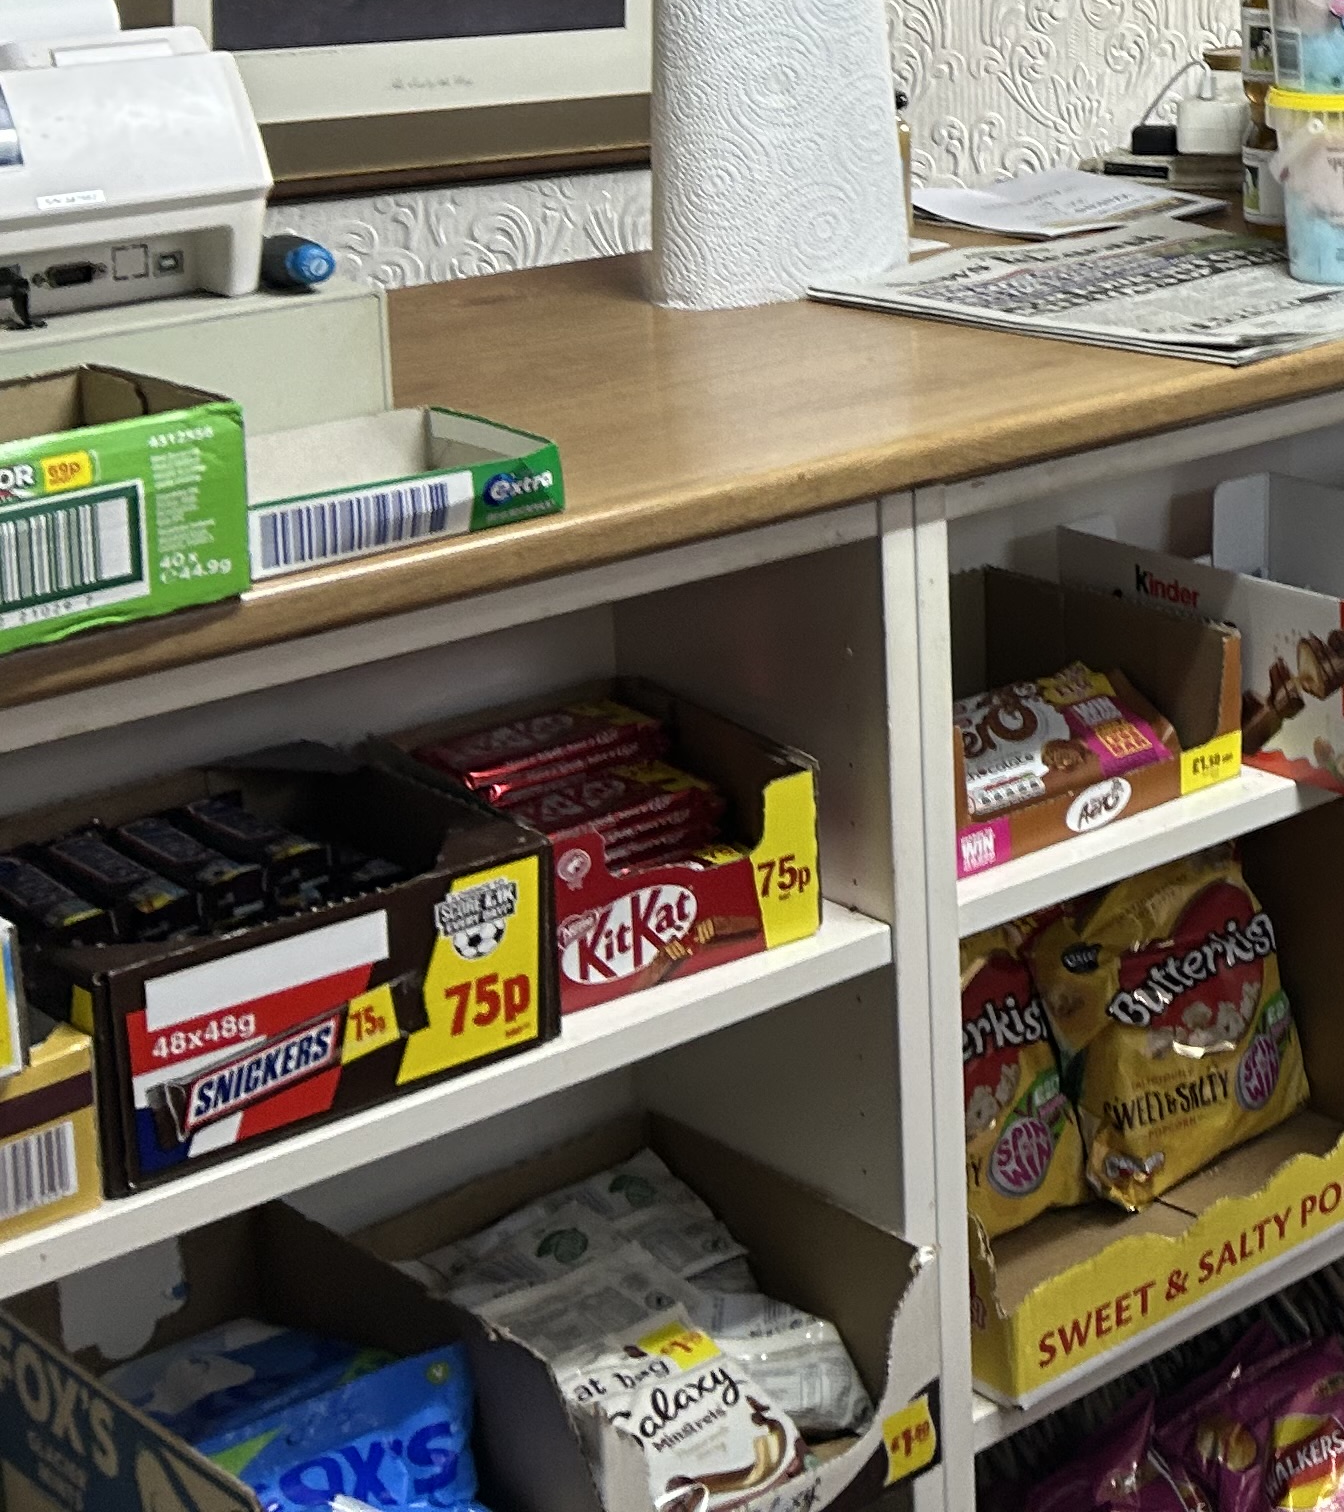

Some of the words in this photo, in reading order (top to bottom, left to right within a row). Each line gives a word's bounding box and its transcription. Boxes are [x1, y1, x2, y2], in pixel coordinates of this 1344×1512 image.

[963, 692, 1039, 759] ero
[1078, 777, 1126, 829] Aero
[757, 854, 812, 898] 75p
[576, 886, 691, 984] KitKat
[151, 1012, 258, 1059] 48x48g
[445, 972, 532, 1038] 75p
[194, 1025, 334, 1118] SNICKERS
[1037, 1279, 1157, 1369] SWEET
[1164, 1268, 1190, 1300] &
[1198, 1206, 1295, 1284] SALTY
[615, 1359, 671, 1390] bag
[278, 1421, 458, 1508] OX'S
